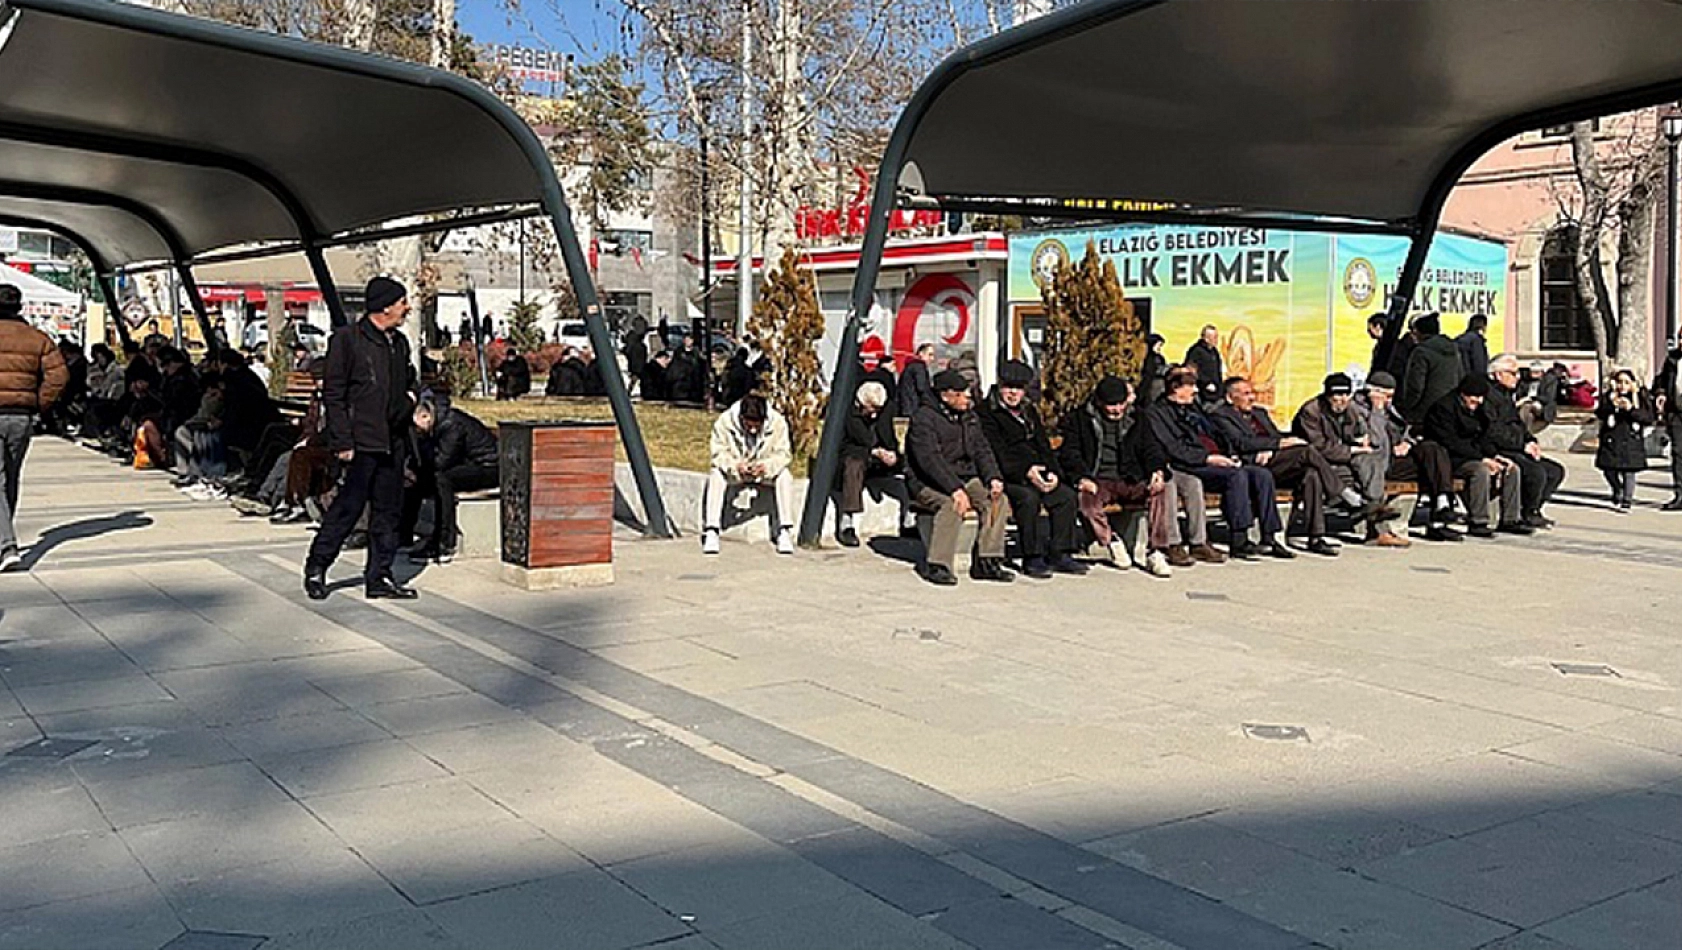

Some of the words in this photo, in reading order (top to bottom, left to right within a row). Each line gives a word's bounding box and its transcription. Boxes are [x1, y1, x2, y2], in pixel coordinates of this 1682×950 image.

[1100, 231, 1160, 254] ELAZIĞ
[1122, 257, 1160, 288] LK
[1171, 249, 1291, 287] EKMEK
[1383, 283, 1433, 311] HLK
[1440, 287, 1498, 316] EKMEK
